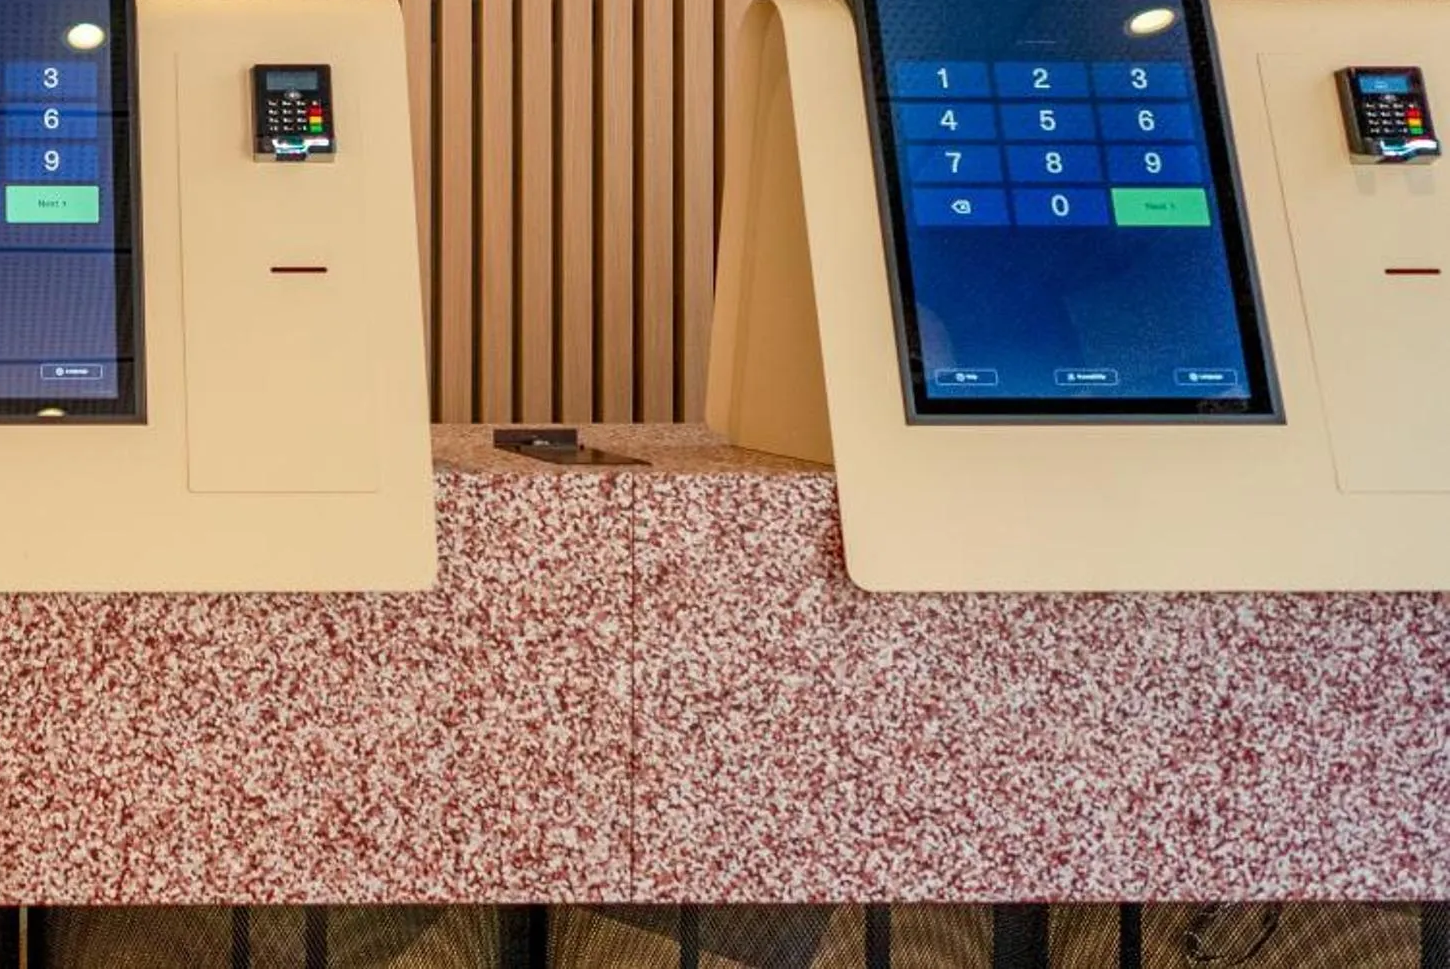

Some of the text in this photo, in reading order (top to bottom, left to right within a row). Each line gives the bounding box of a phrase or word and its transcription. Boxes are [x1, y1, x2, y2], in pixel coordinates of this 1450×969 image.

[44, 68, 58, 88] 3
[938, 68, 1147, 88] 1 2 3
[44, 109, 58, 128] 6
[941, 110, 1154, 130] 4 5 6
[45, 151, 59, 171] 9
[946, 152, 1161, 173] 7 8 9
[1052, 195, 1069, 216] 0
